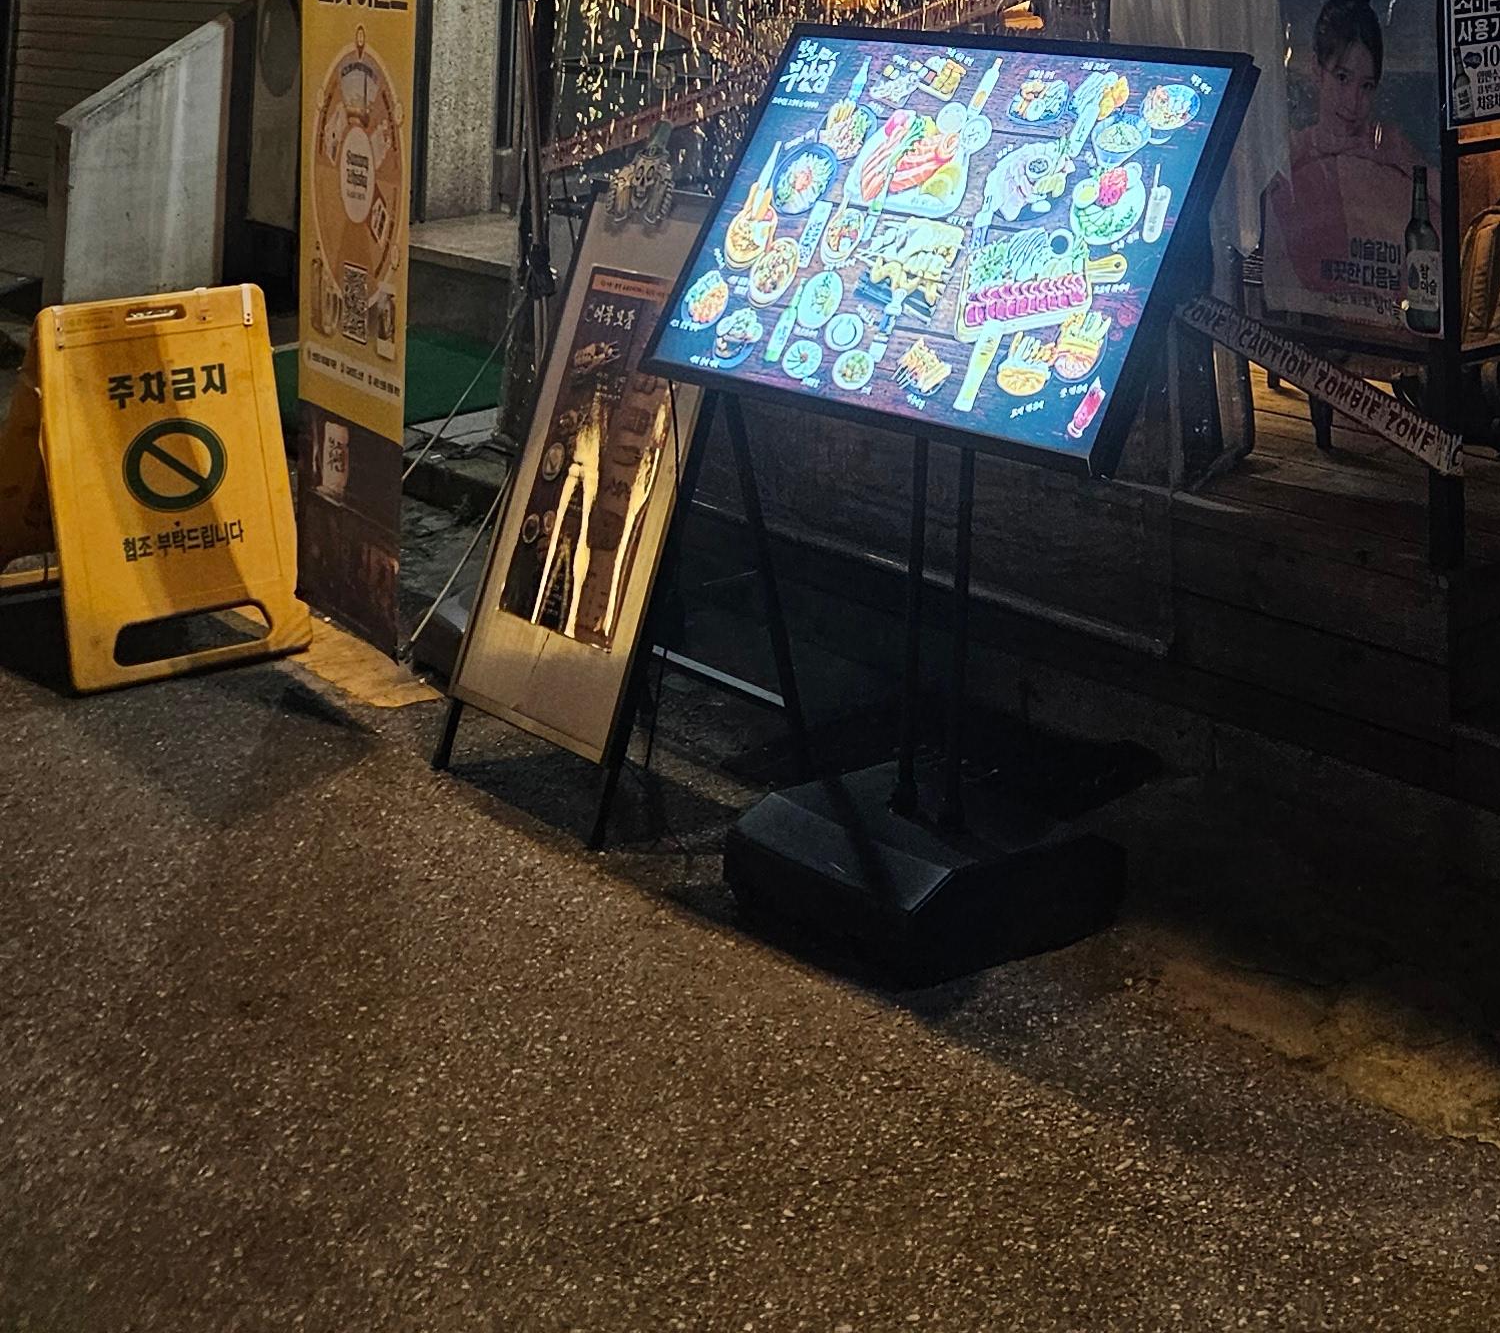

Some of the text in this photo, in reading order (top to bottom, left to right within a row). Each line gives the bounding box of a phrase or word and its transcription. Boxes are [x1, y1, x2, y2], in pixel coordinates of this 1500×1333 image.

[1350, 236, 1401, 265] 이슬같이
[1362, 265, 1401, 291] 다음날
[108, 362, 228, 410] 주차금지
[1239, 331, 1312, 377] CAUTION
[1314, 370, 1383, 421] ZOMBIE
[1384, 408, 1435, 452] ZONE
[123, 519, 245, 563] 협조 부탁드립니다
